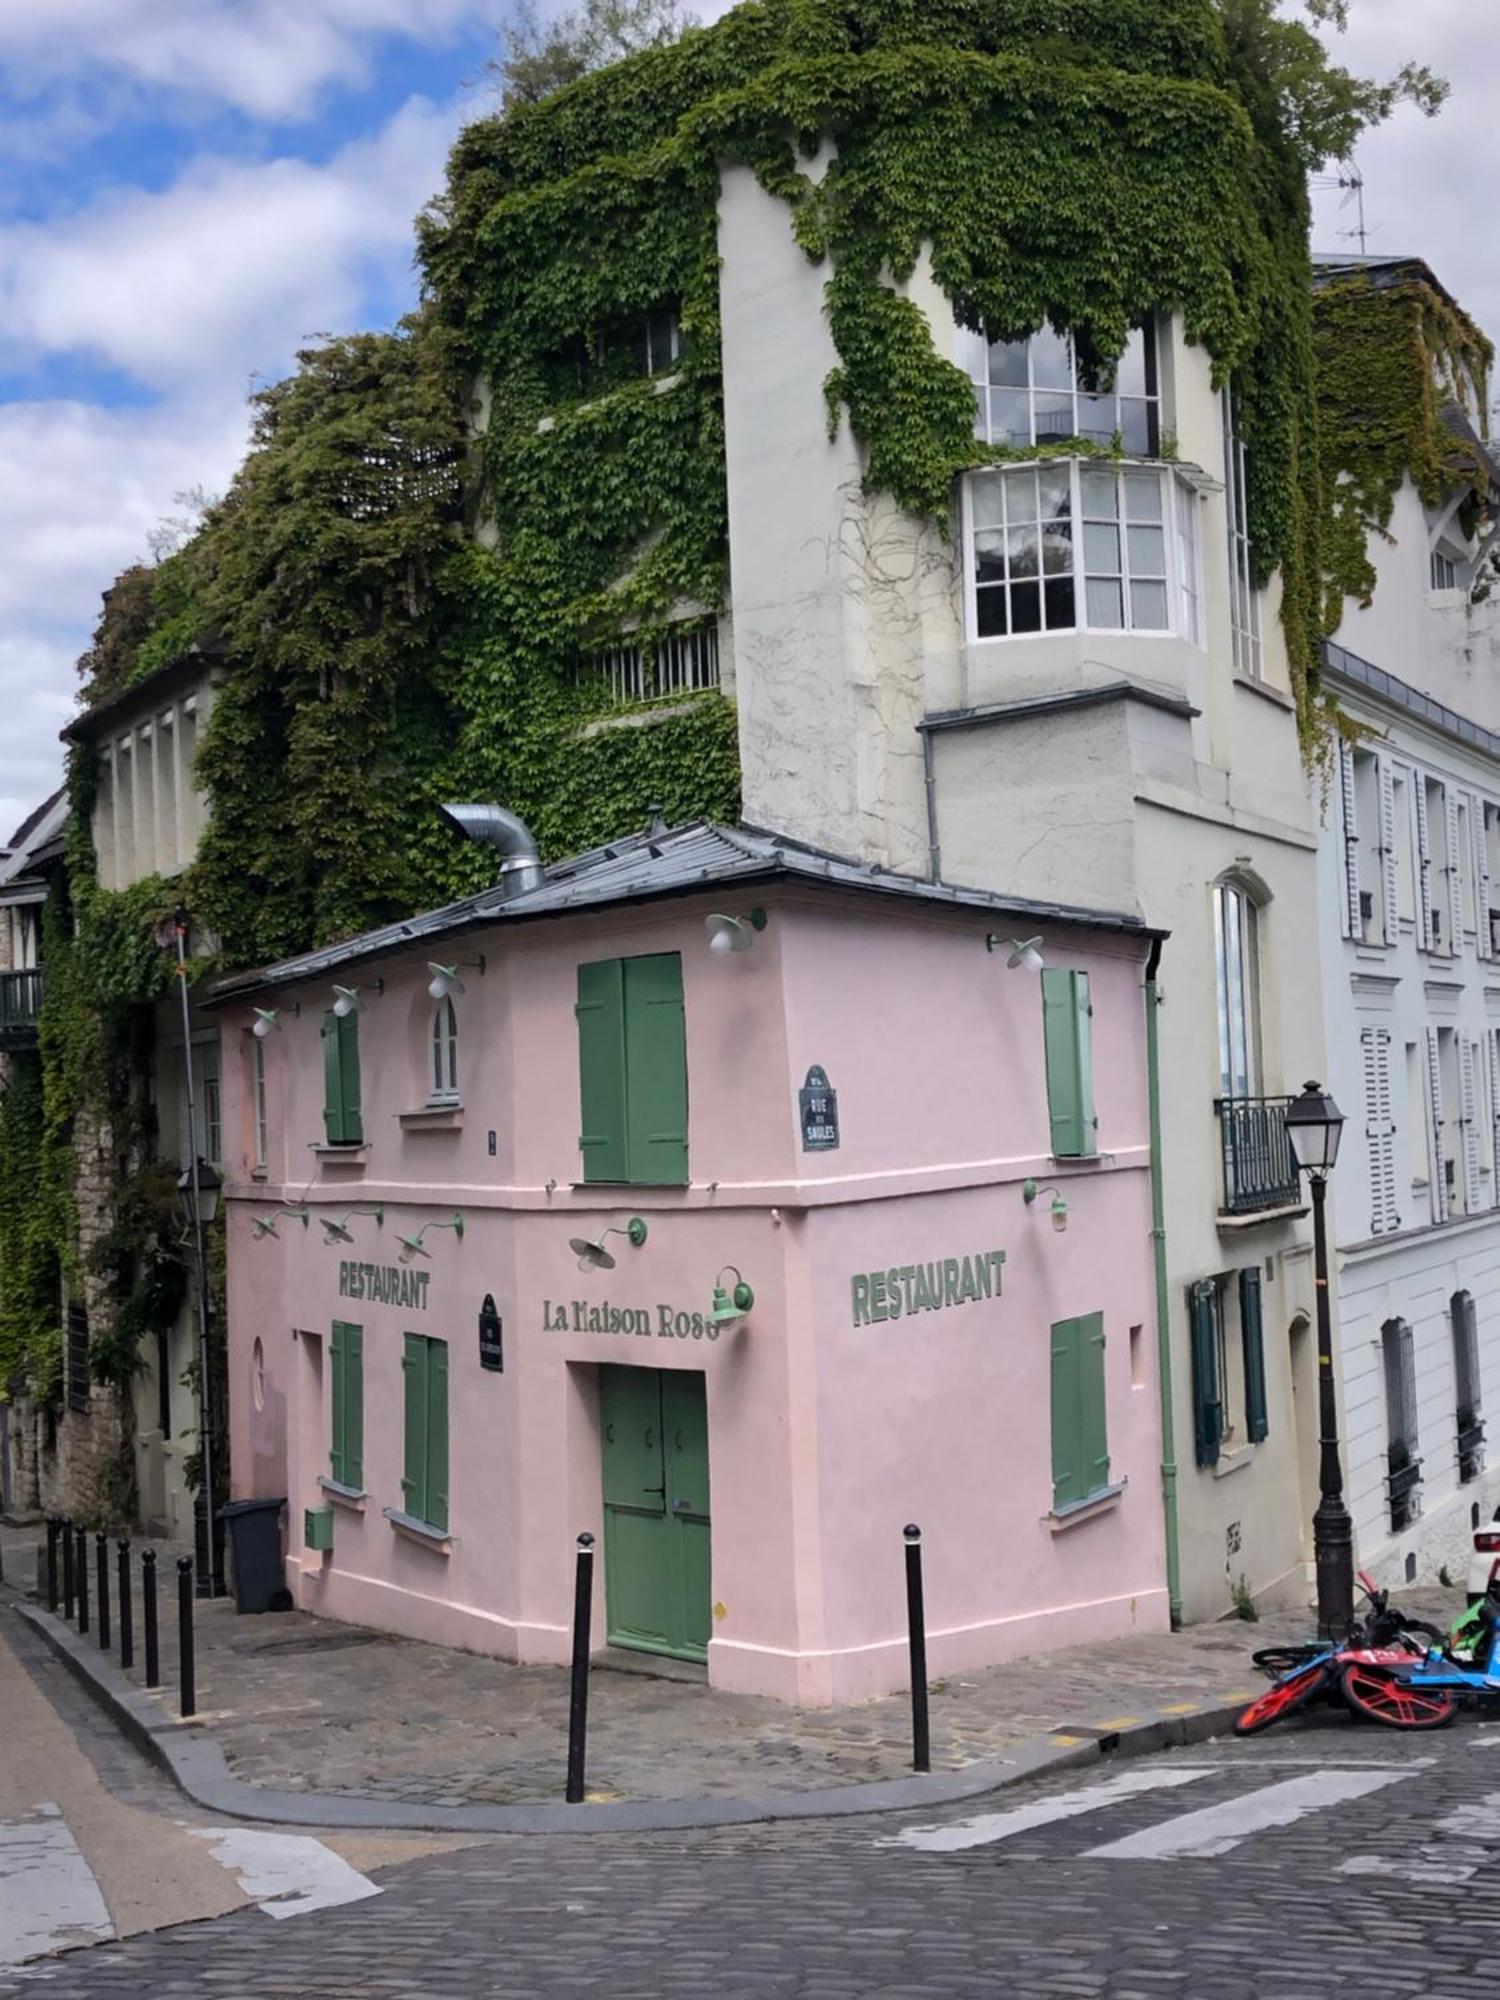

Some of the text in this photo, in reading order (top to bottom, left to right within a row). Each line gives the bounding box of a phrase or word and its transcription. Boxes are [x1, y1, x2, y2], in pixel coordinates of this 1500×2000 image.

[807, 1125, 835, 1139] SAULES
[339, 1260, 430, 1310] RESTAURANT
[851, 1250, 1007, 1328] RESTAURANT
[543, 1300, 569, 1331] La
[571, 1300, 651, 1336] Maison
